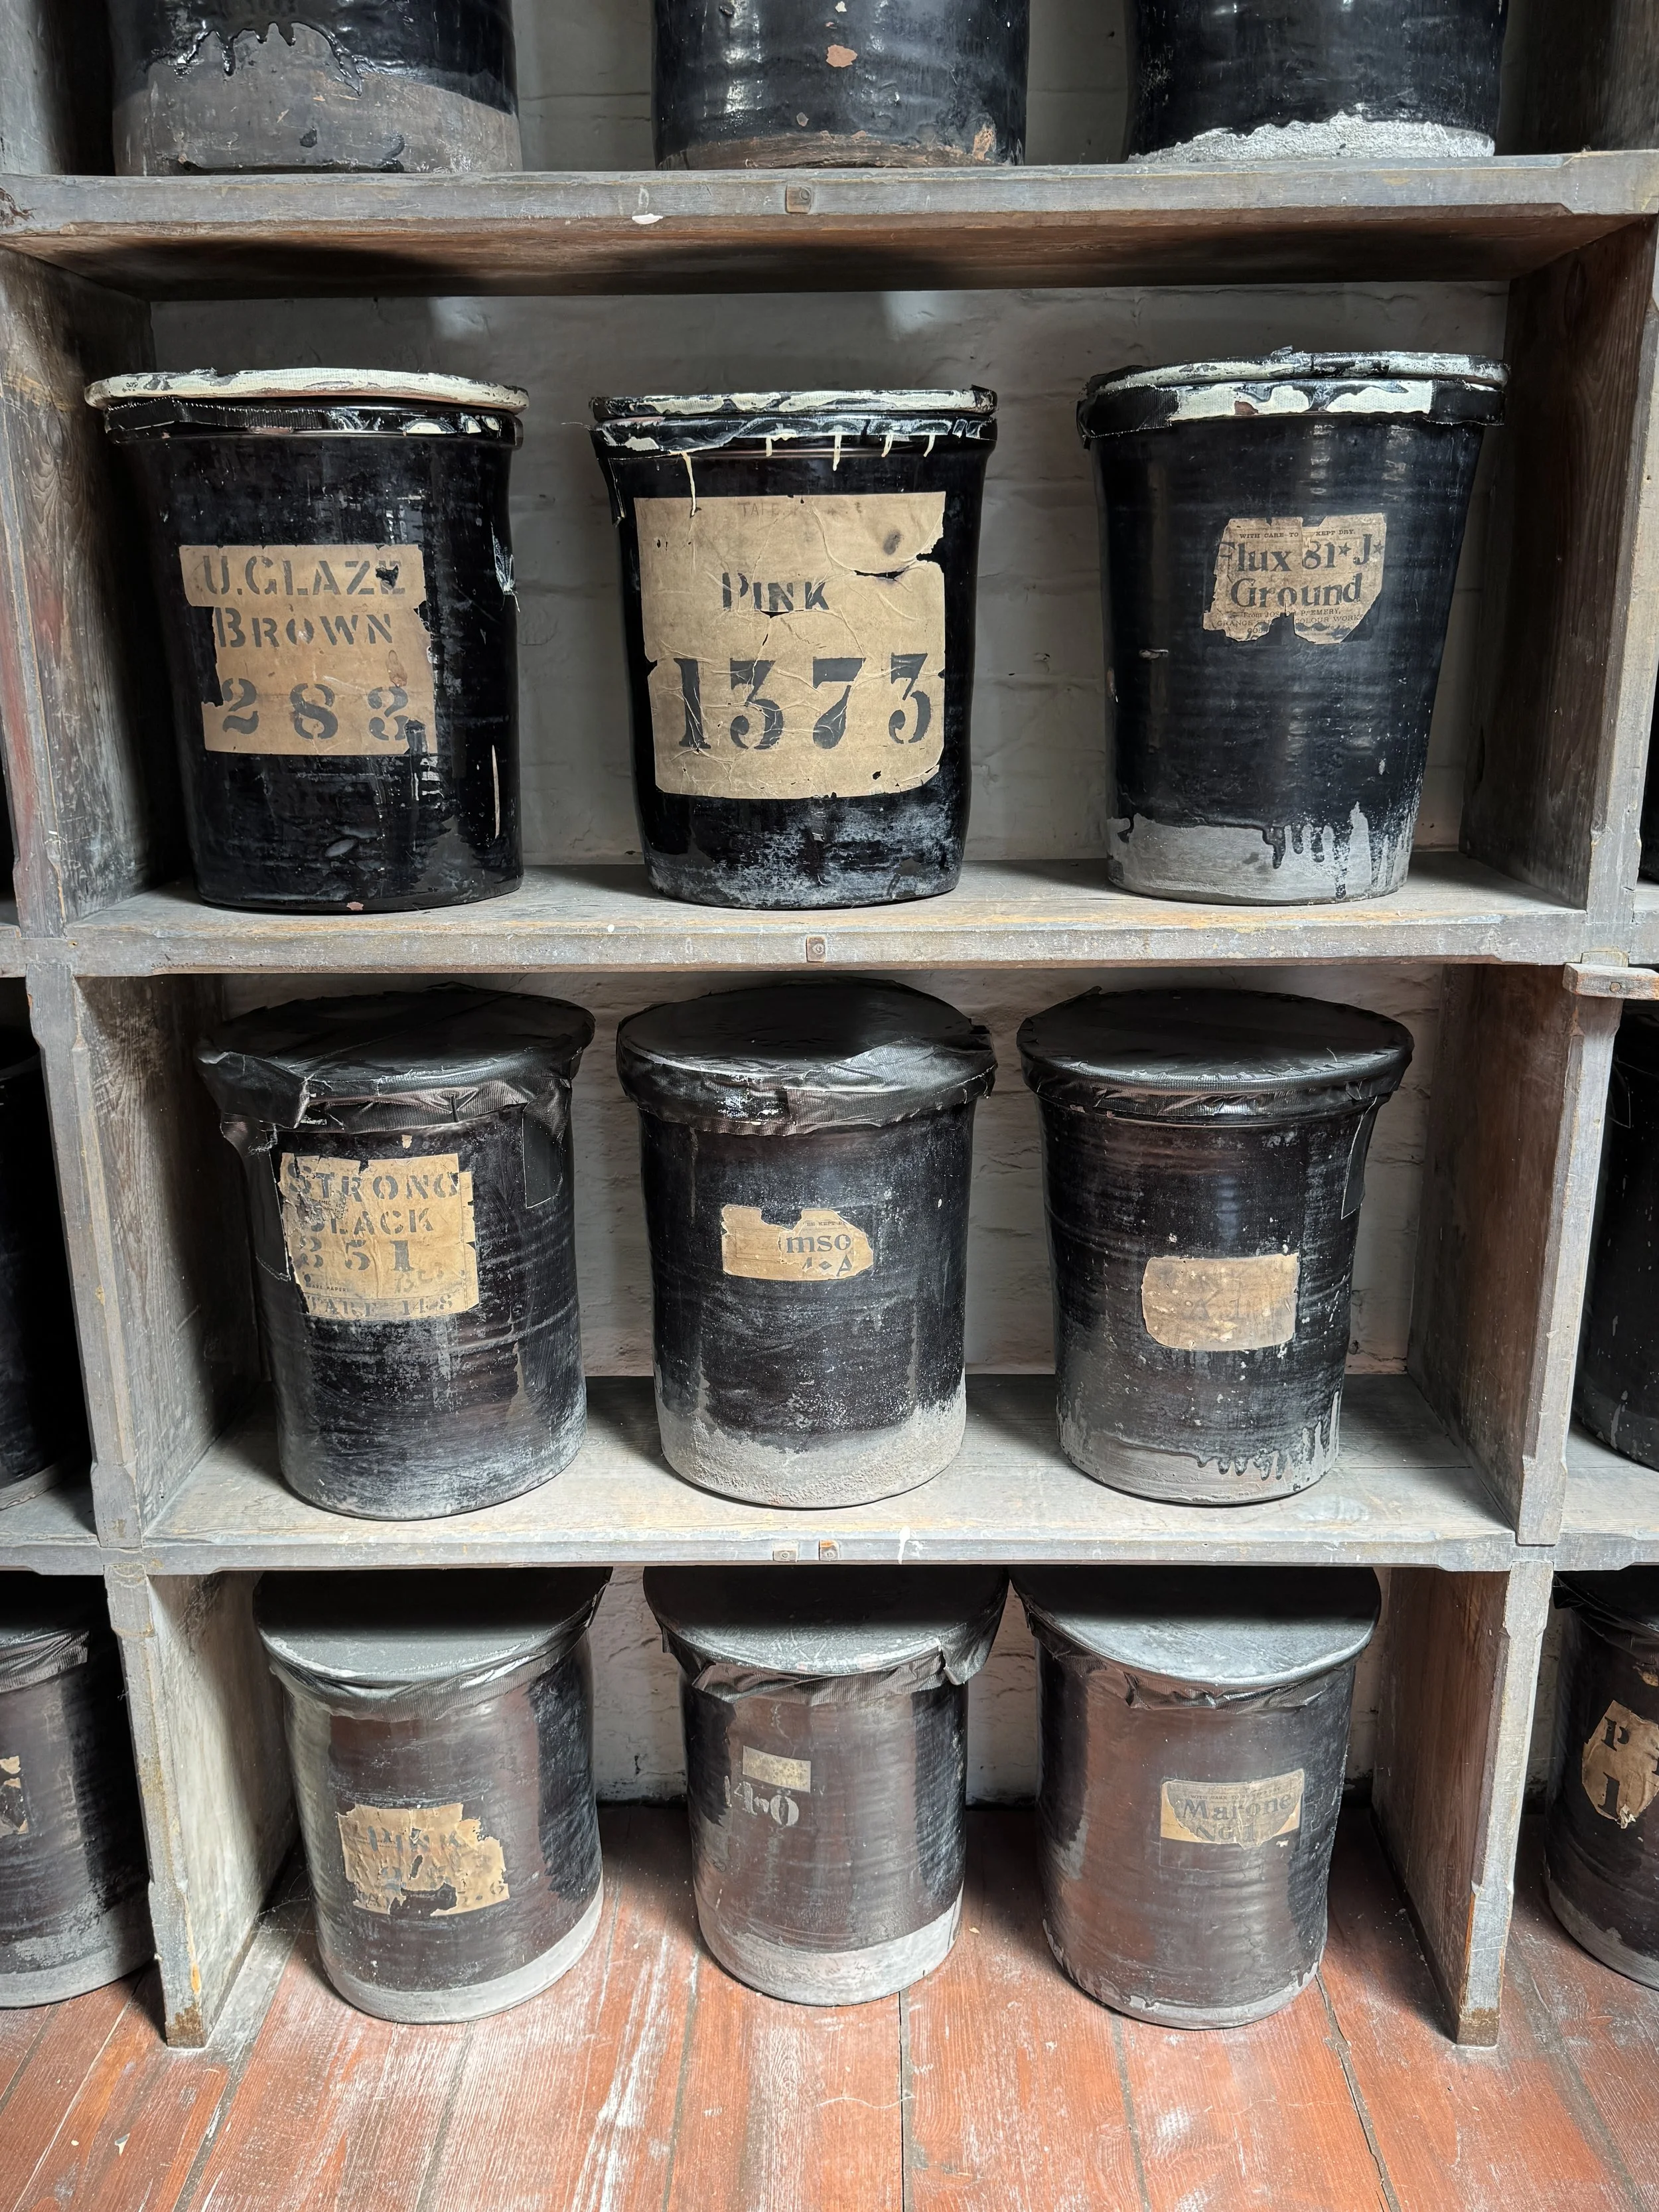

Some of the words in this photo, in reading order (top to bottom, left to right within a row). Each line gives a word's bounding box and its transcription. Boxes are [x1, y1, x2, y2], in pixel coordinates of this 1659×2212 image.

[1219, 541, 1293, 572] Flux
[722, 571, 830, 611] PINK
[1230, 572, 1363, 609] Ground
[215, 607, 393, 648] BROWN
[673, 652, 932, 751] 1373
[287, 1162, 460, 1203] STRONG
[1183, 1793, 1291, 1820] Marone
